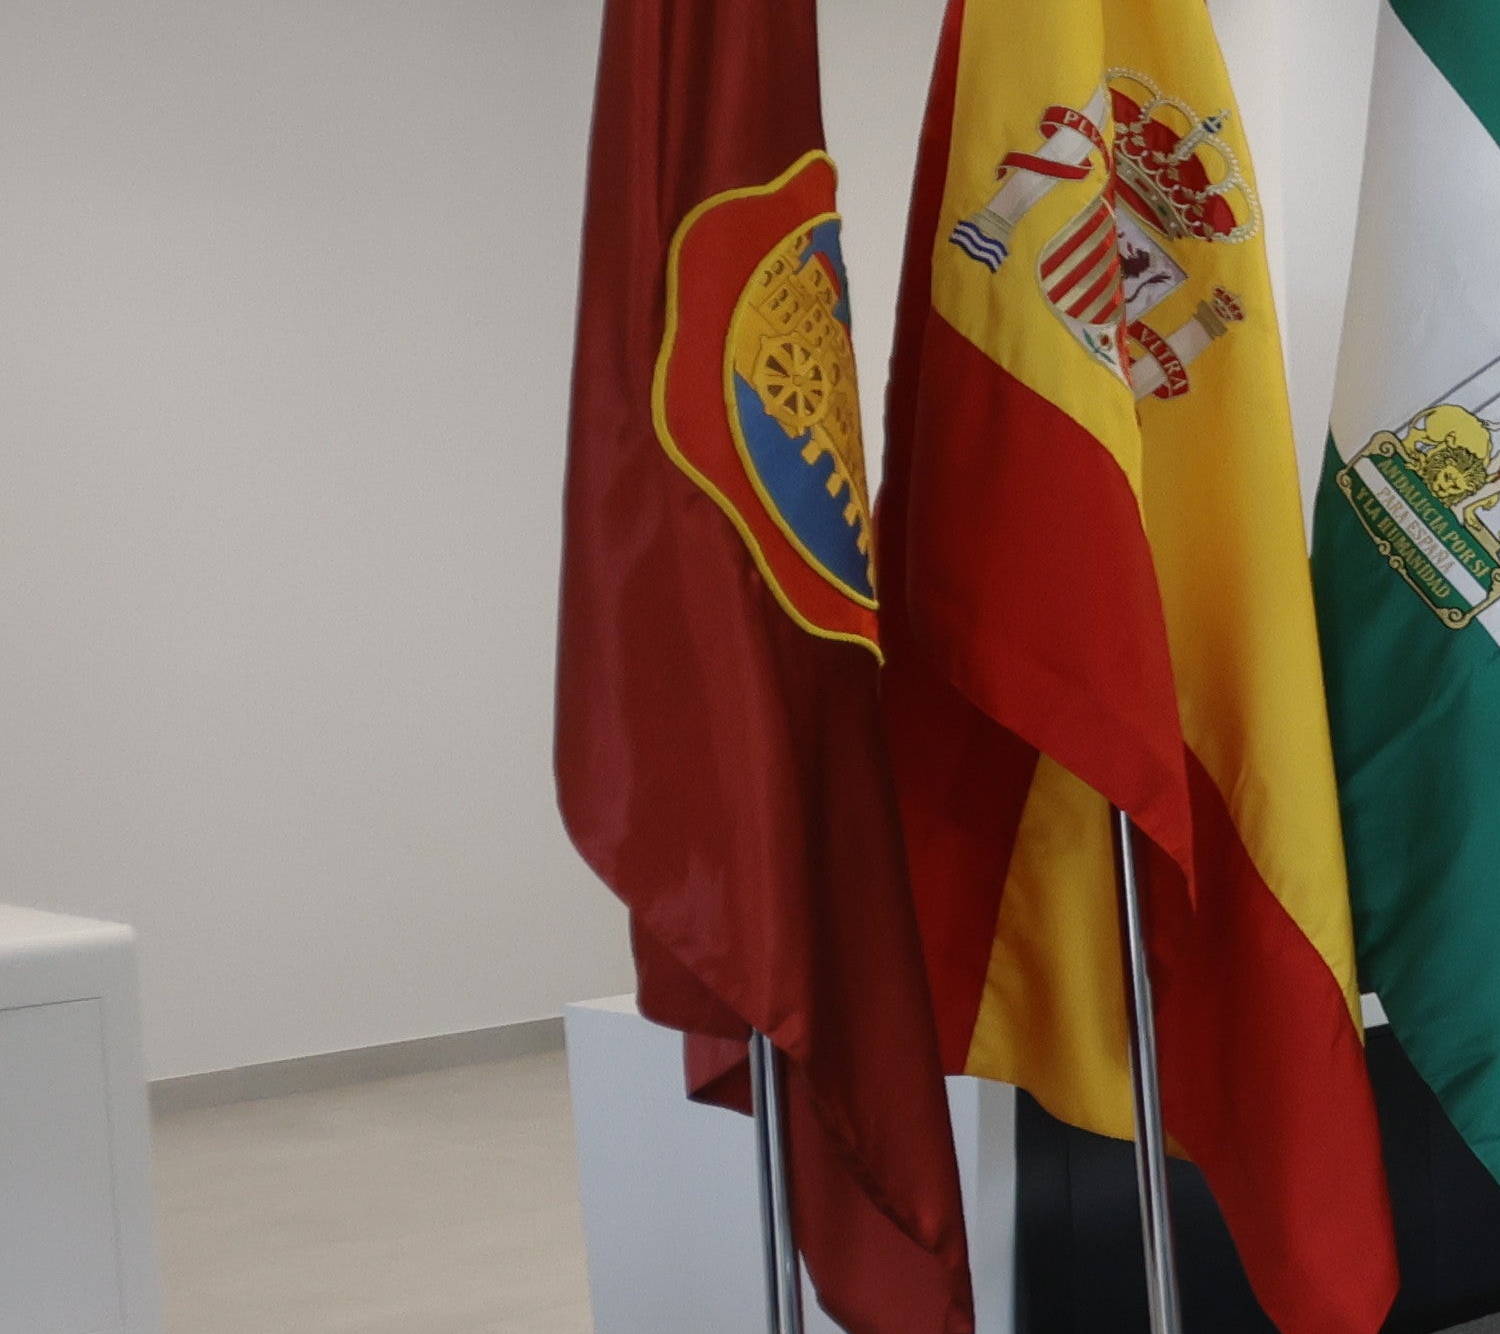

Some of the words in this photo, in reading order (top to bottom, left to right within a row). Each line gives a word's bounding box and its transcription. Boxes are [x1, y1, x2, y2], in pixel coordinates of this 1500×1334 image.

[1355, 486, 1370, 502] Y
[1363, 497, 1382, 522] LA
[1377, 517, 1451, 599] HUMANIDAD
[1376, 486, 1410, 525] PARA
[1405, 519, 1457, 574] ESPAÑA
[1443, 530, 1477, 564] POR
